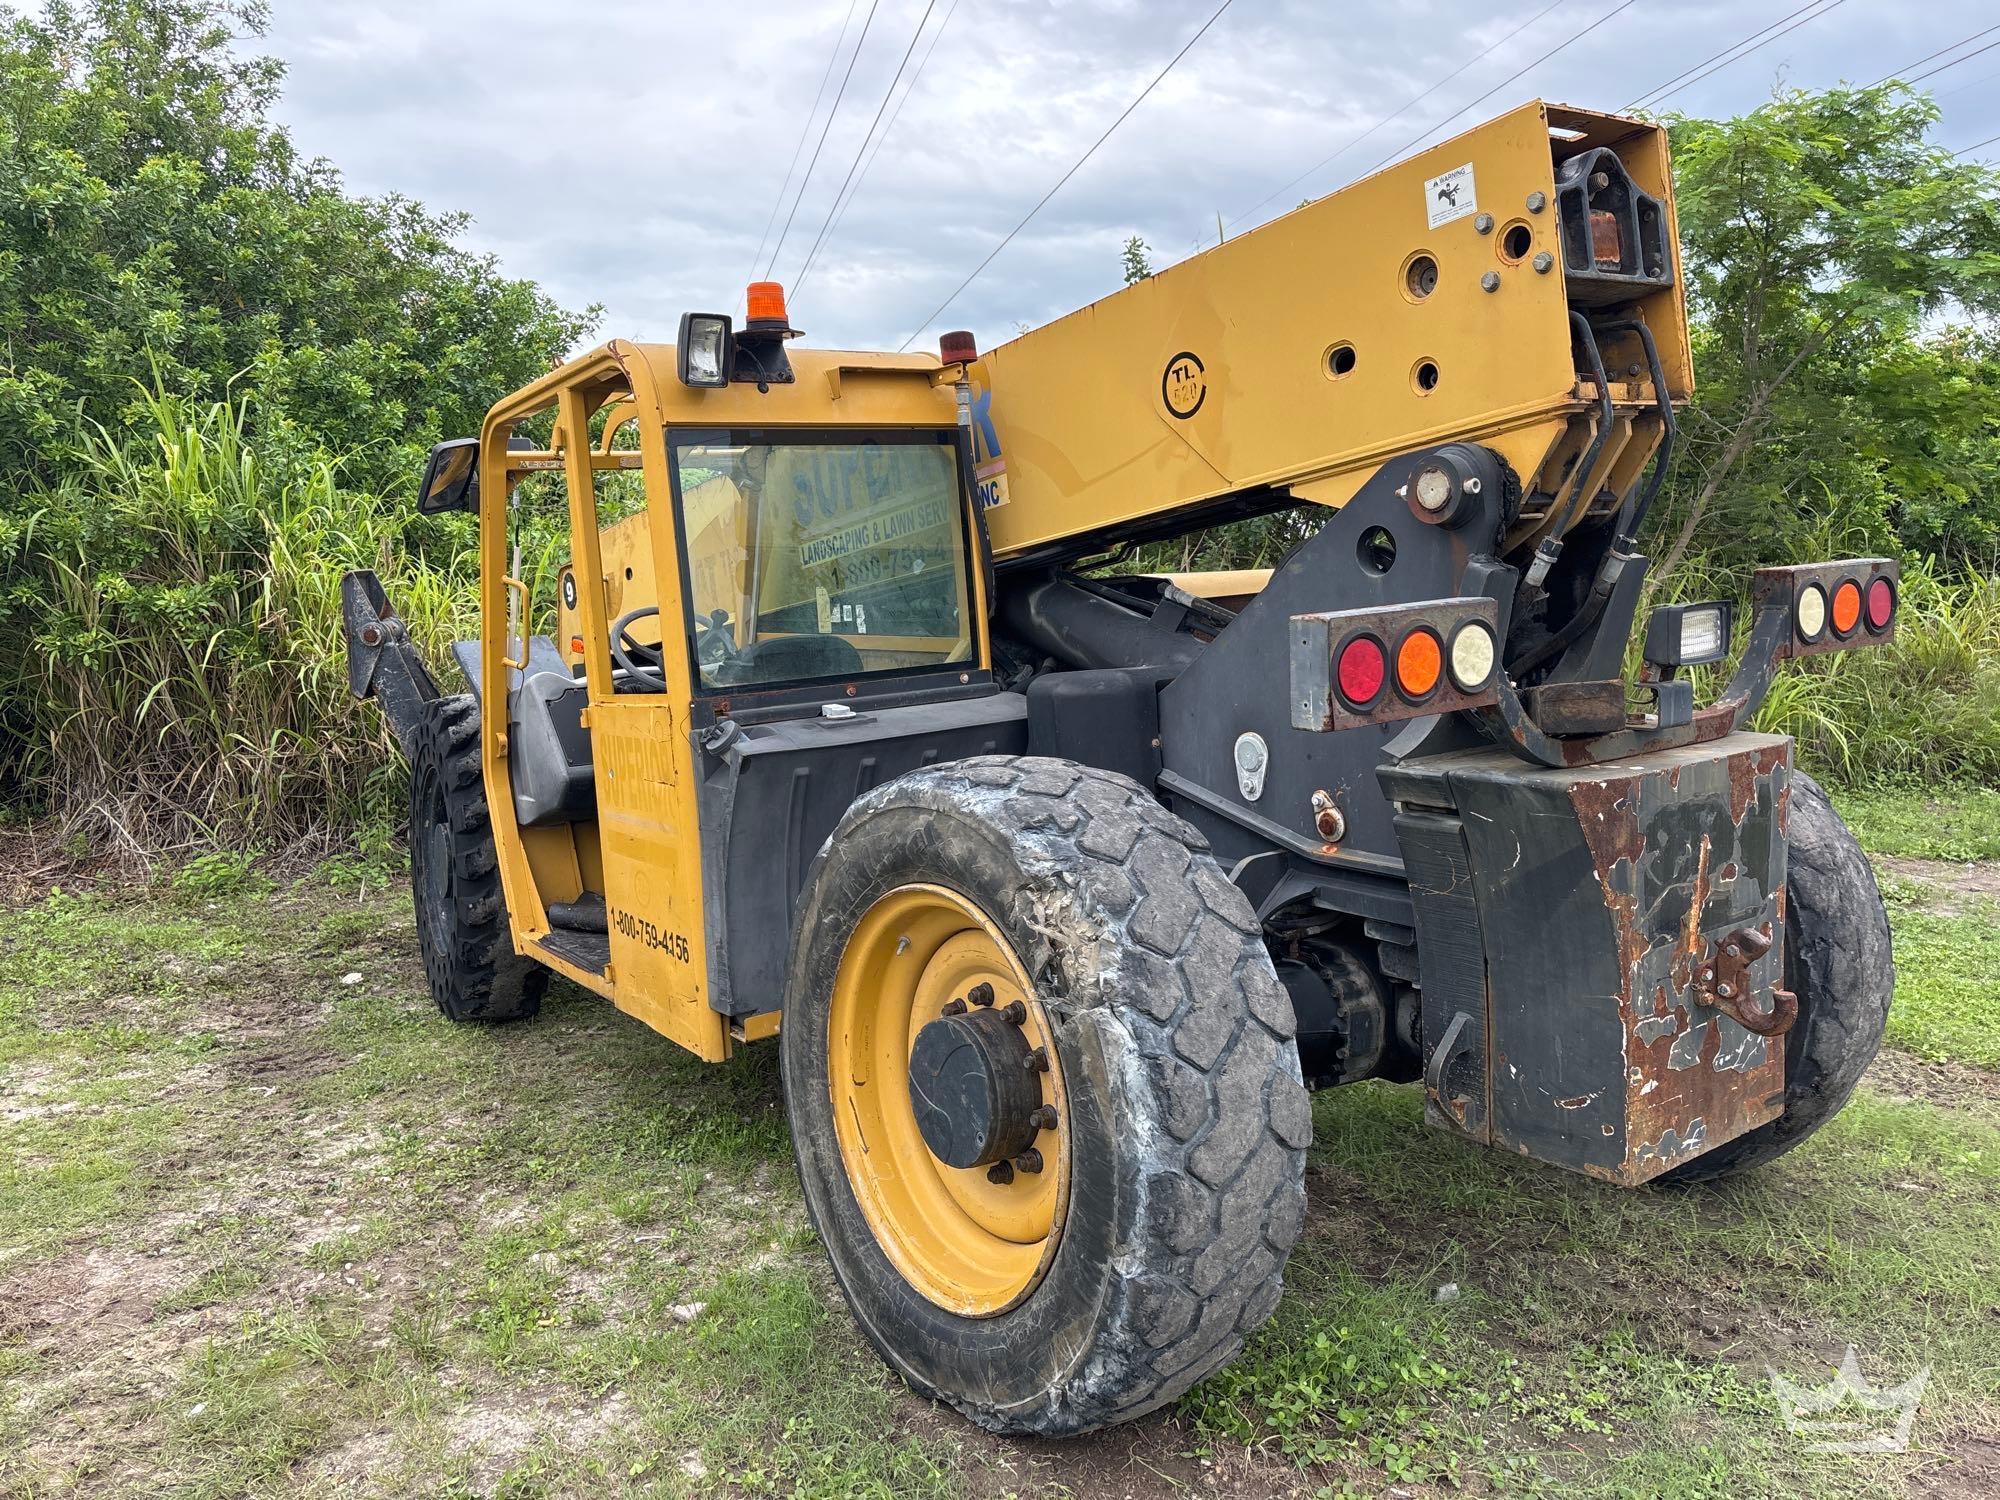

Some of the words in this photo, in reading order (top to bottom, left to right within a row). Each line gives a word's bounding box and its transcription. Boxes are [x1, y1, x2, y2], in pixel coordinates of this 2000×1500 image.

[979, 480, 1000, 507] NC
[802, 525, 869, 565] LANDSCAPING
[872, 521, 881, 542] &
[883, 512, 915, 539] LAWN
[566, 581, 574, 602] 9
[611, 906, 690, 964] 1-800-759-4156
